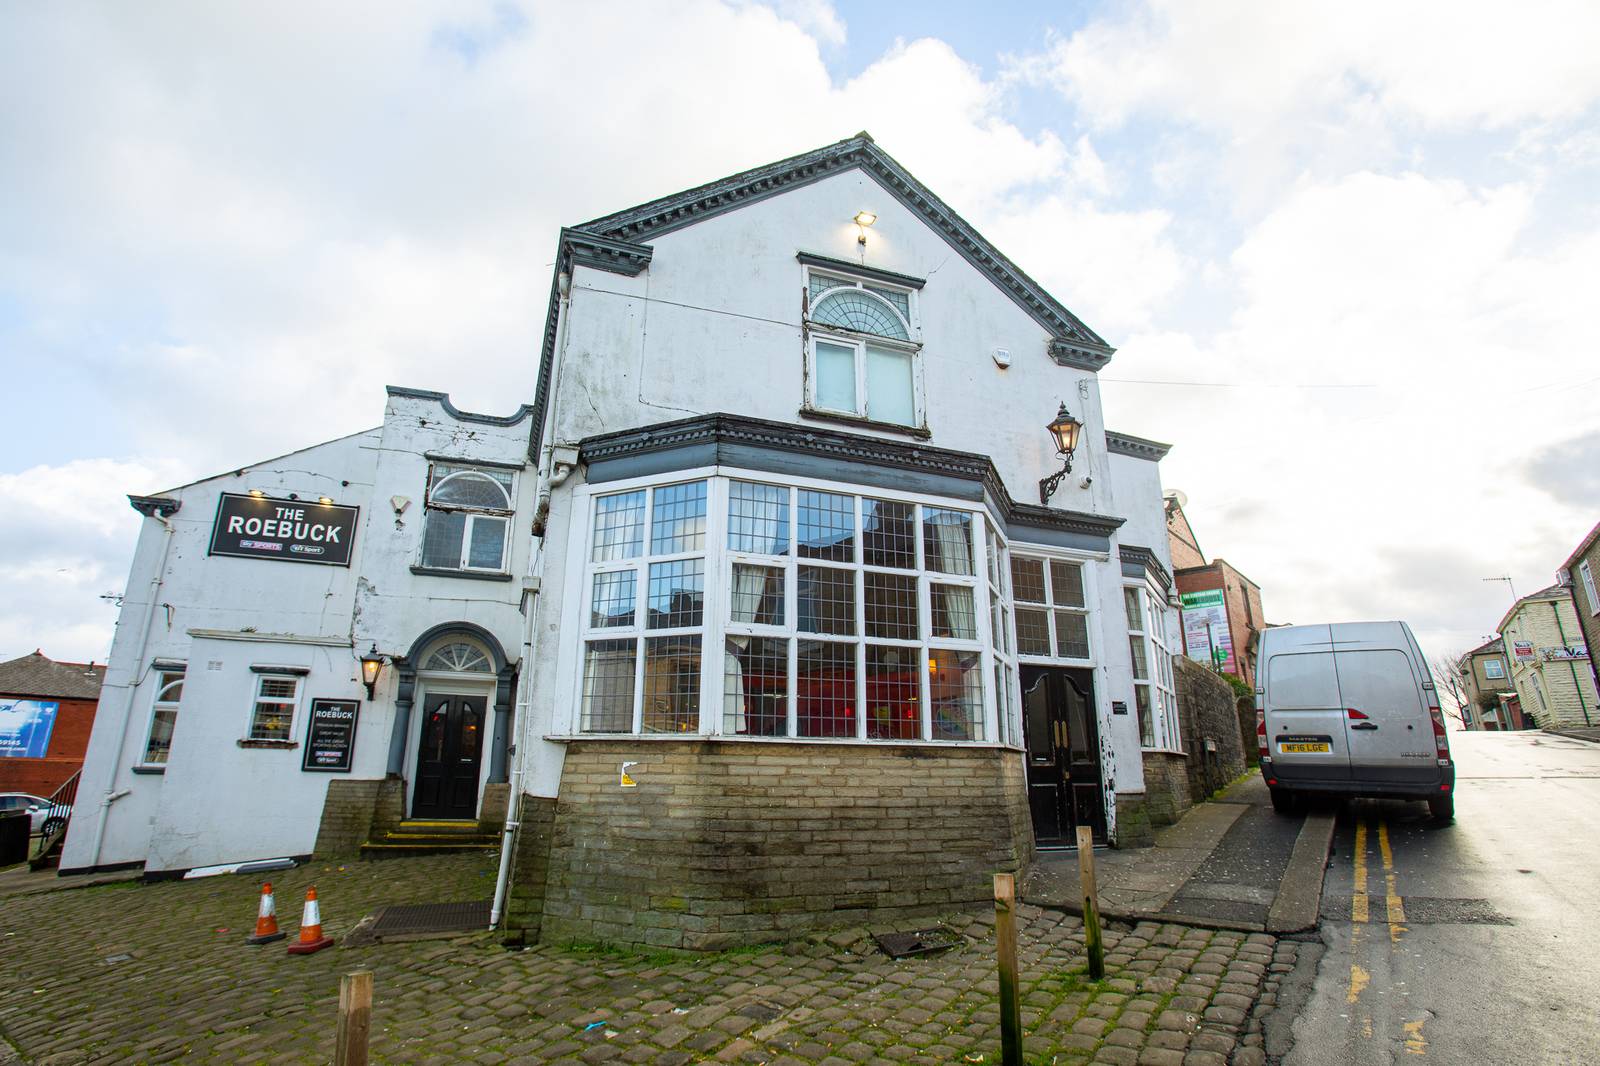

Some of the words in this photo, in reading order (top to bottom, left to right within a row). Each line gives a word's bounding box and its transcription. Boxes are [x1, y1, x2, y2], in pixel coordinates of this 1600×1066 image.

[275, 507, 305, 521] THE
[227, 515, 342, 544] ROEBUCK
[316, 711, 353, 719] ROEBUCK
[1287, 743, 1306, 752] MF16
[1307, 743, 1324, 752] LGE
